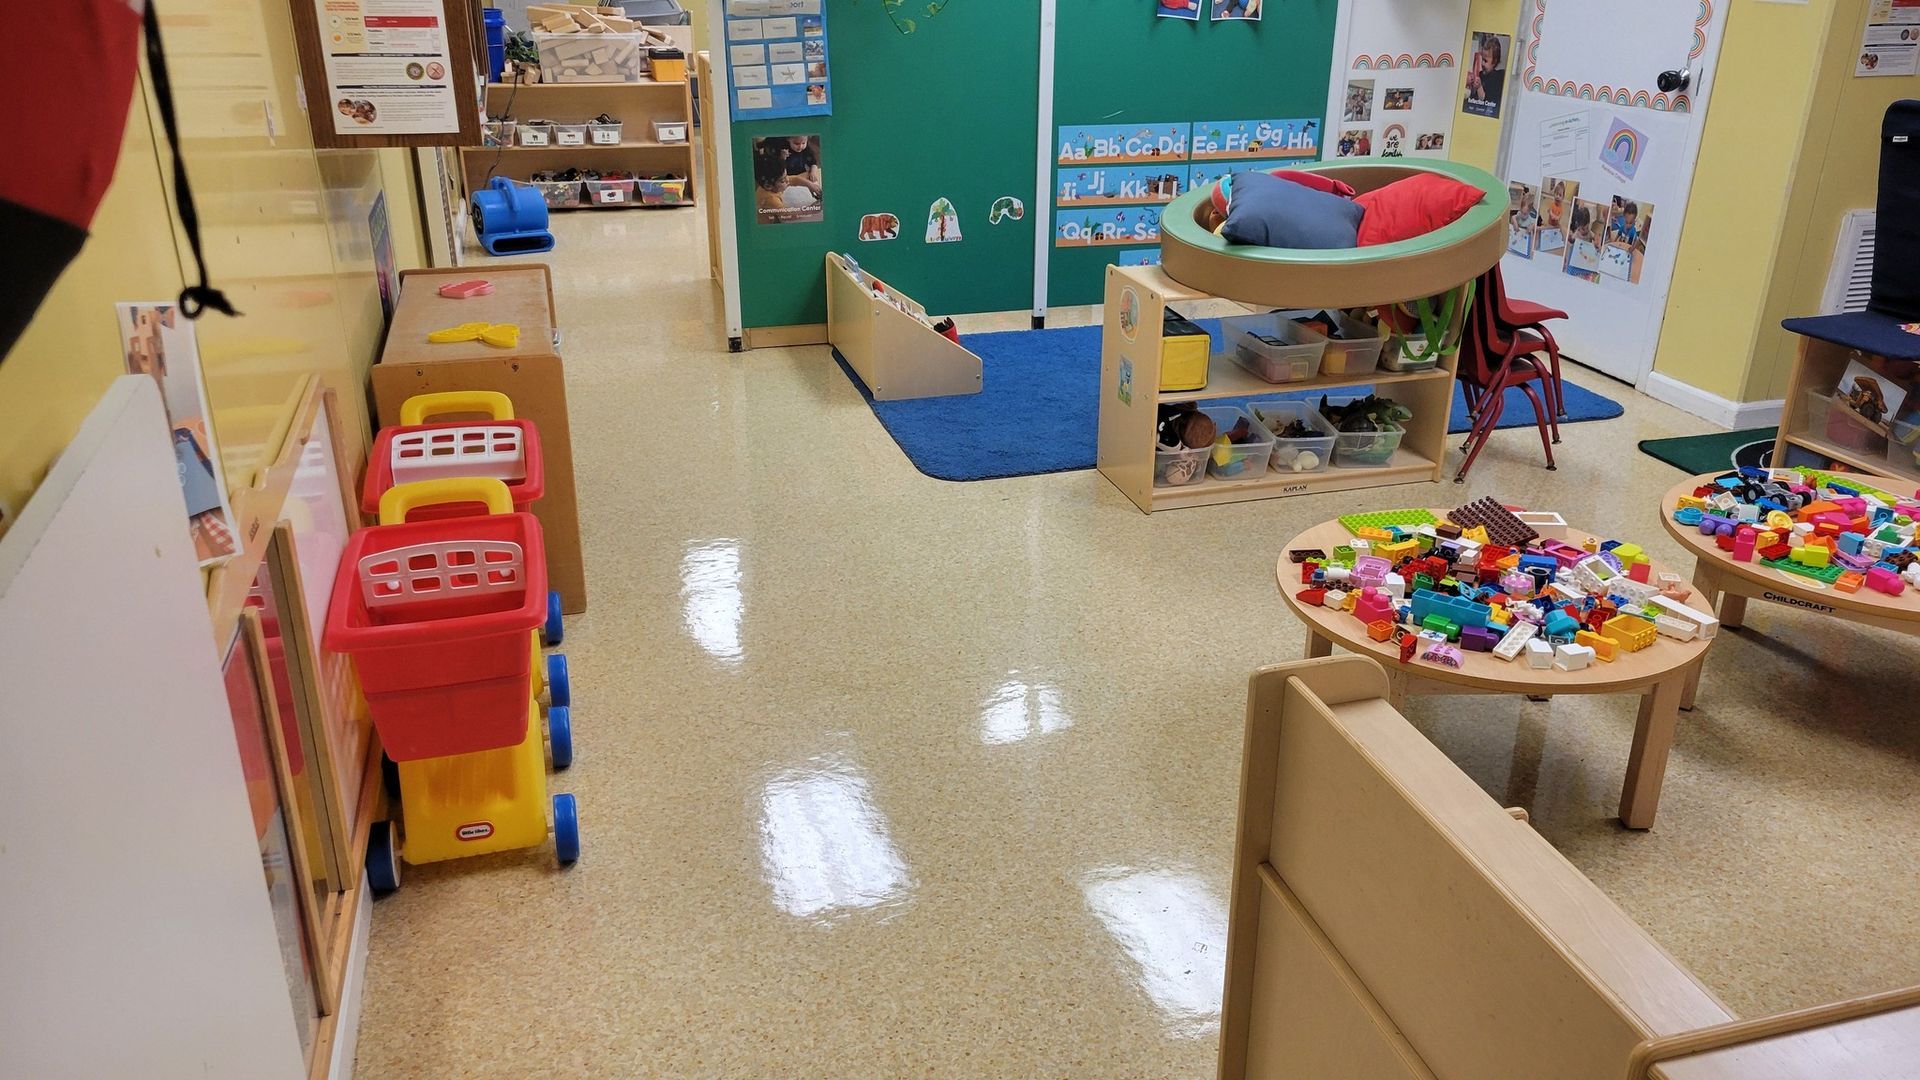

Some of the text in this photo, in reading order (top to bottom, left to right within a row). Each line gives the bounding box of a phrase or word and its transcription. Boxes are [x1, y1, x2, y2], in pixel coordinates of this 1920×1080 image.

[1059, 134, 1185, 160] Aa Bb Cc Dd
[1192, 122, 1313, 154] Ee Ff Gg Hh
[1386, 141, 1400, 149] are
[1062, 182, 1077, 201] Ii
[1088, 171, 1106, 195] Jj
[1120, 179, 1147, 199] Kk
[758, 204, 821, 214] Communication Center
[1063, 222, 1157, 244] Qq Rr Ss
[1283, 484, 1308, 492] KAPLAN
[1763, 591, 1837, 613] CHILDCRAFT
